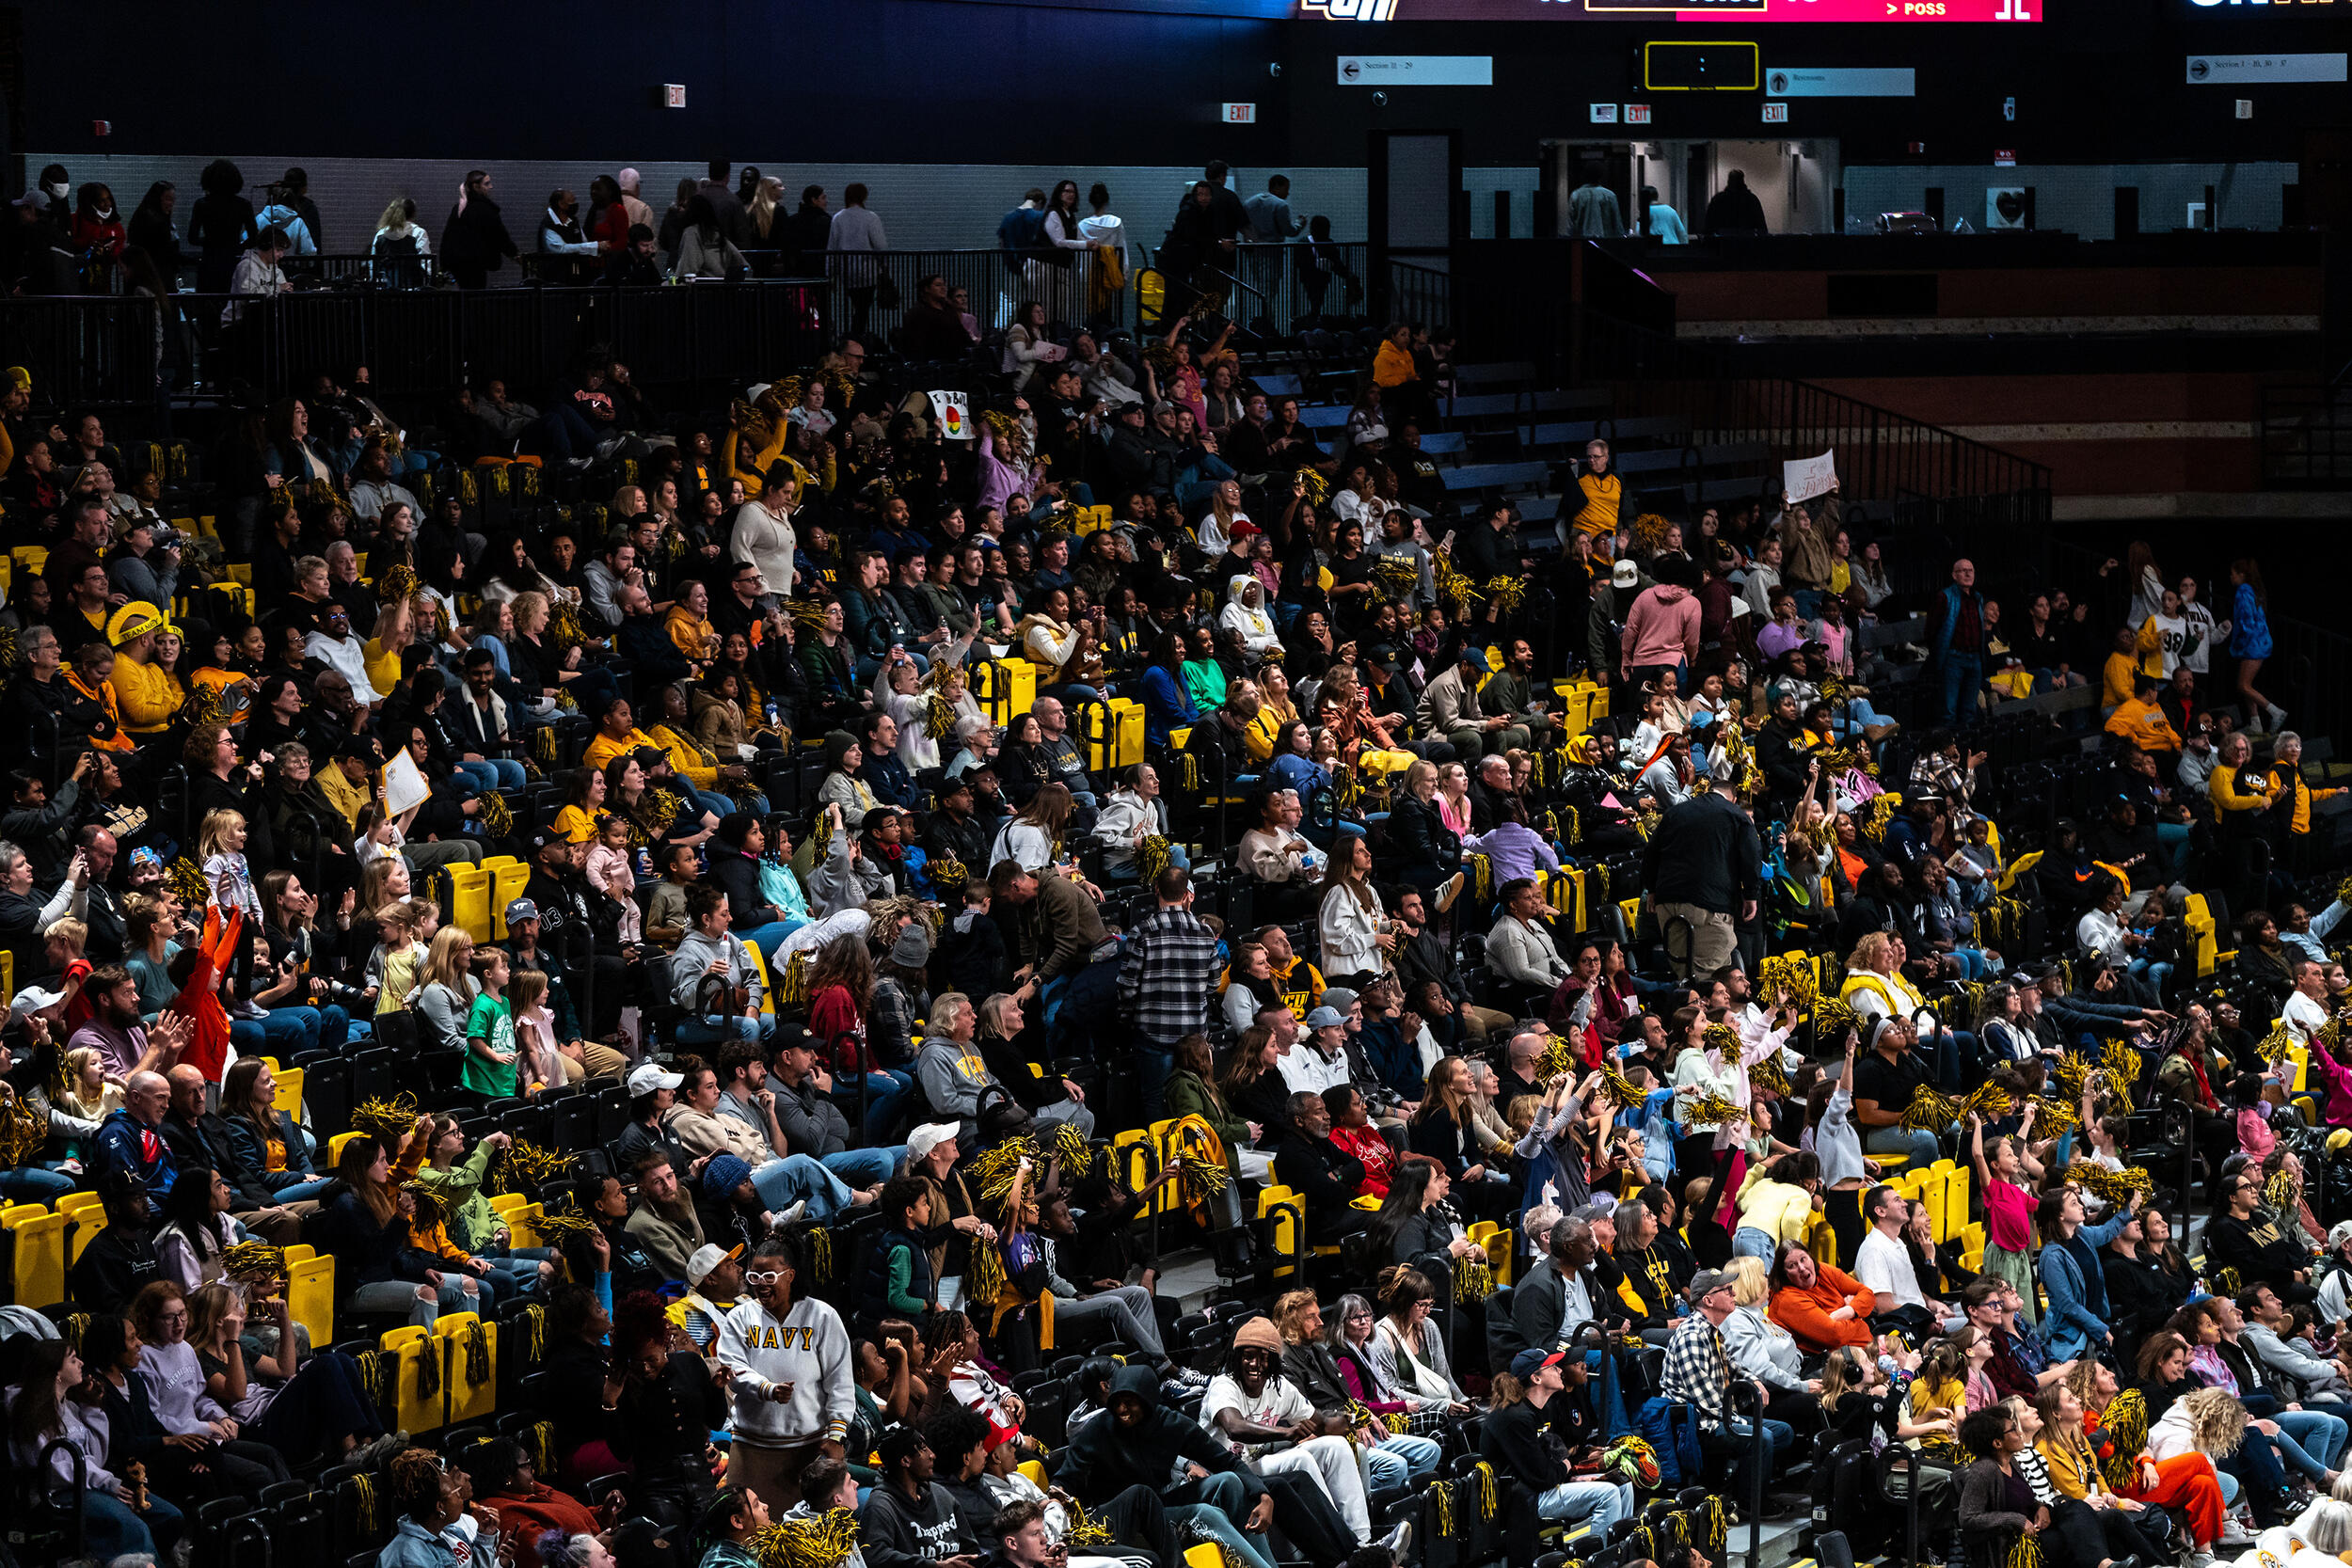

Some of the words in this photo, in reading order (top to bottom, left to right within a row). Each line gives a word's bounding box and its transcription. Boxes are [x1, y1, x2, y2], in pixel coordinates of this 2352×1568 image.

[1903, 3, 1947, 16] POSS
[1364, 61, 1389, 70] Section
[2214, 60, 2238, 69] Section
[1230, 105, 1250, 121] EXIT
[1629, 105, 1648, 121] EXIT
[1765, 104, 1785, 121] EXIT
[122, 624, 145, 641] TEAM
[748, 1324, 814, 1352] NAVY
[910, 1513, 958, 1542] Trapped
